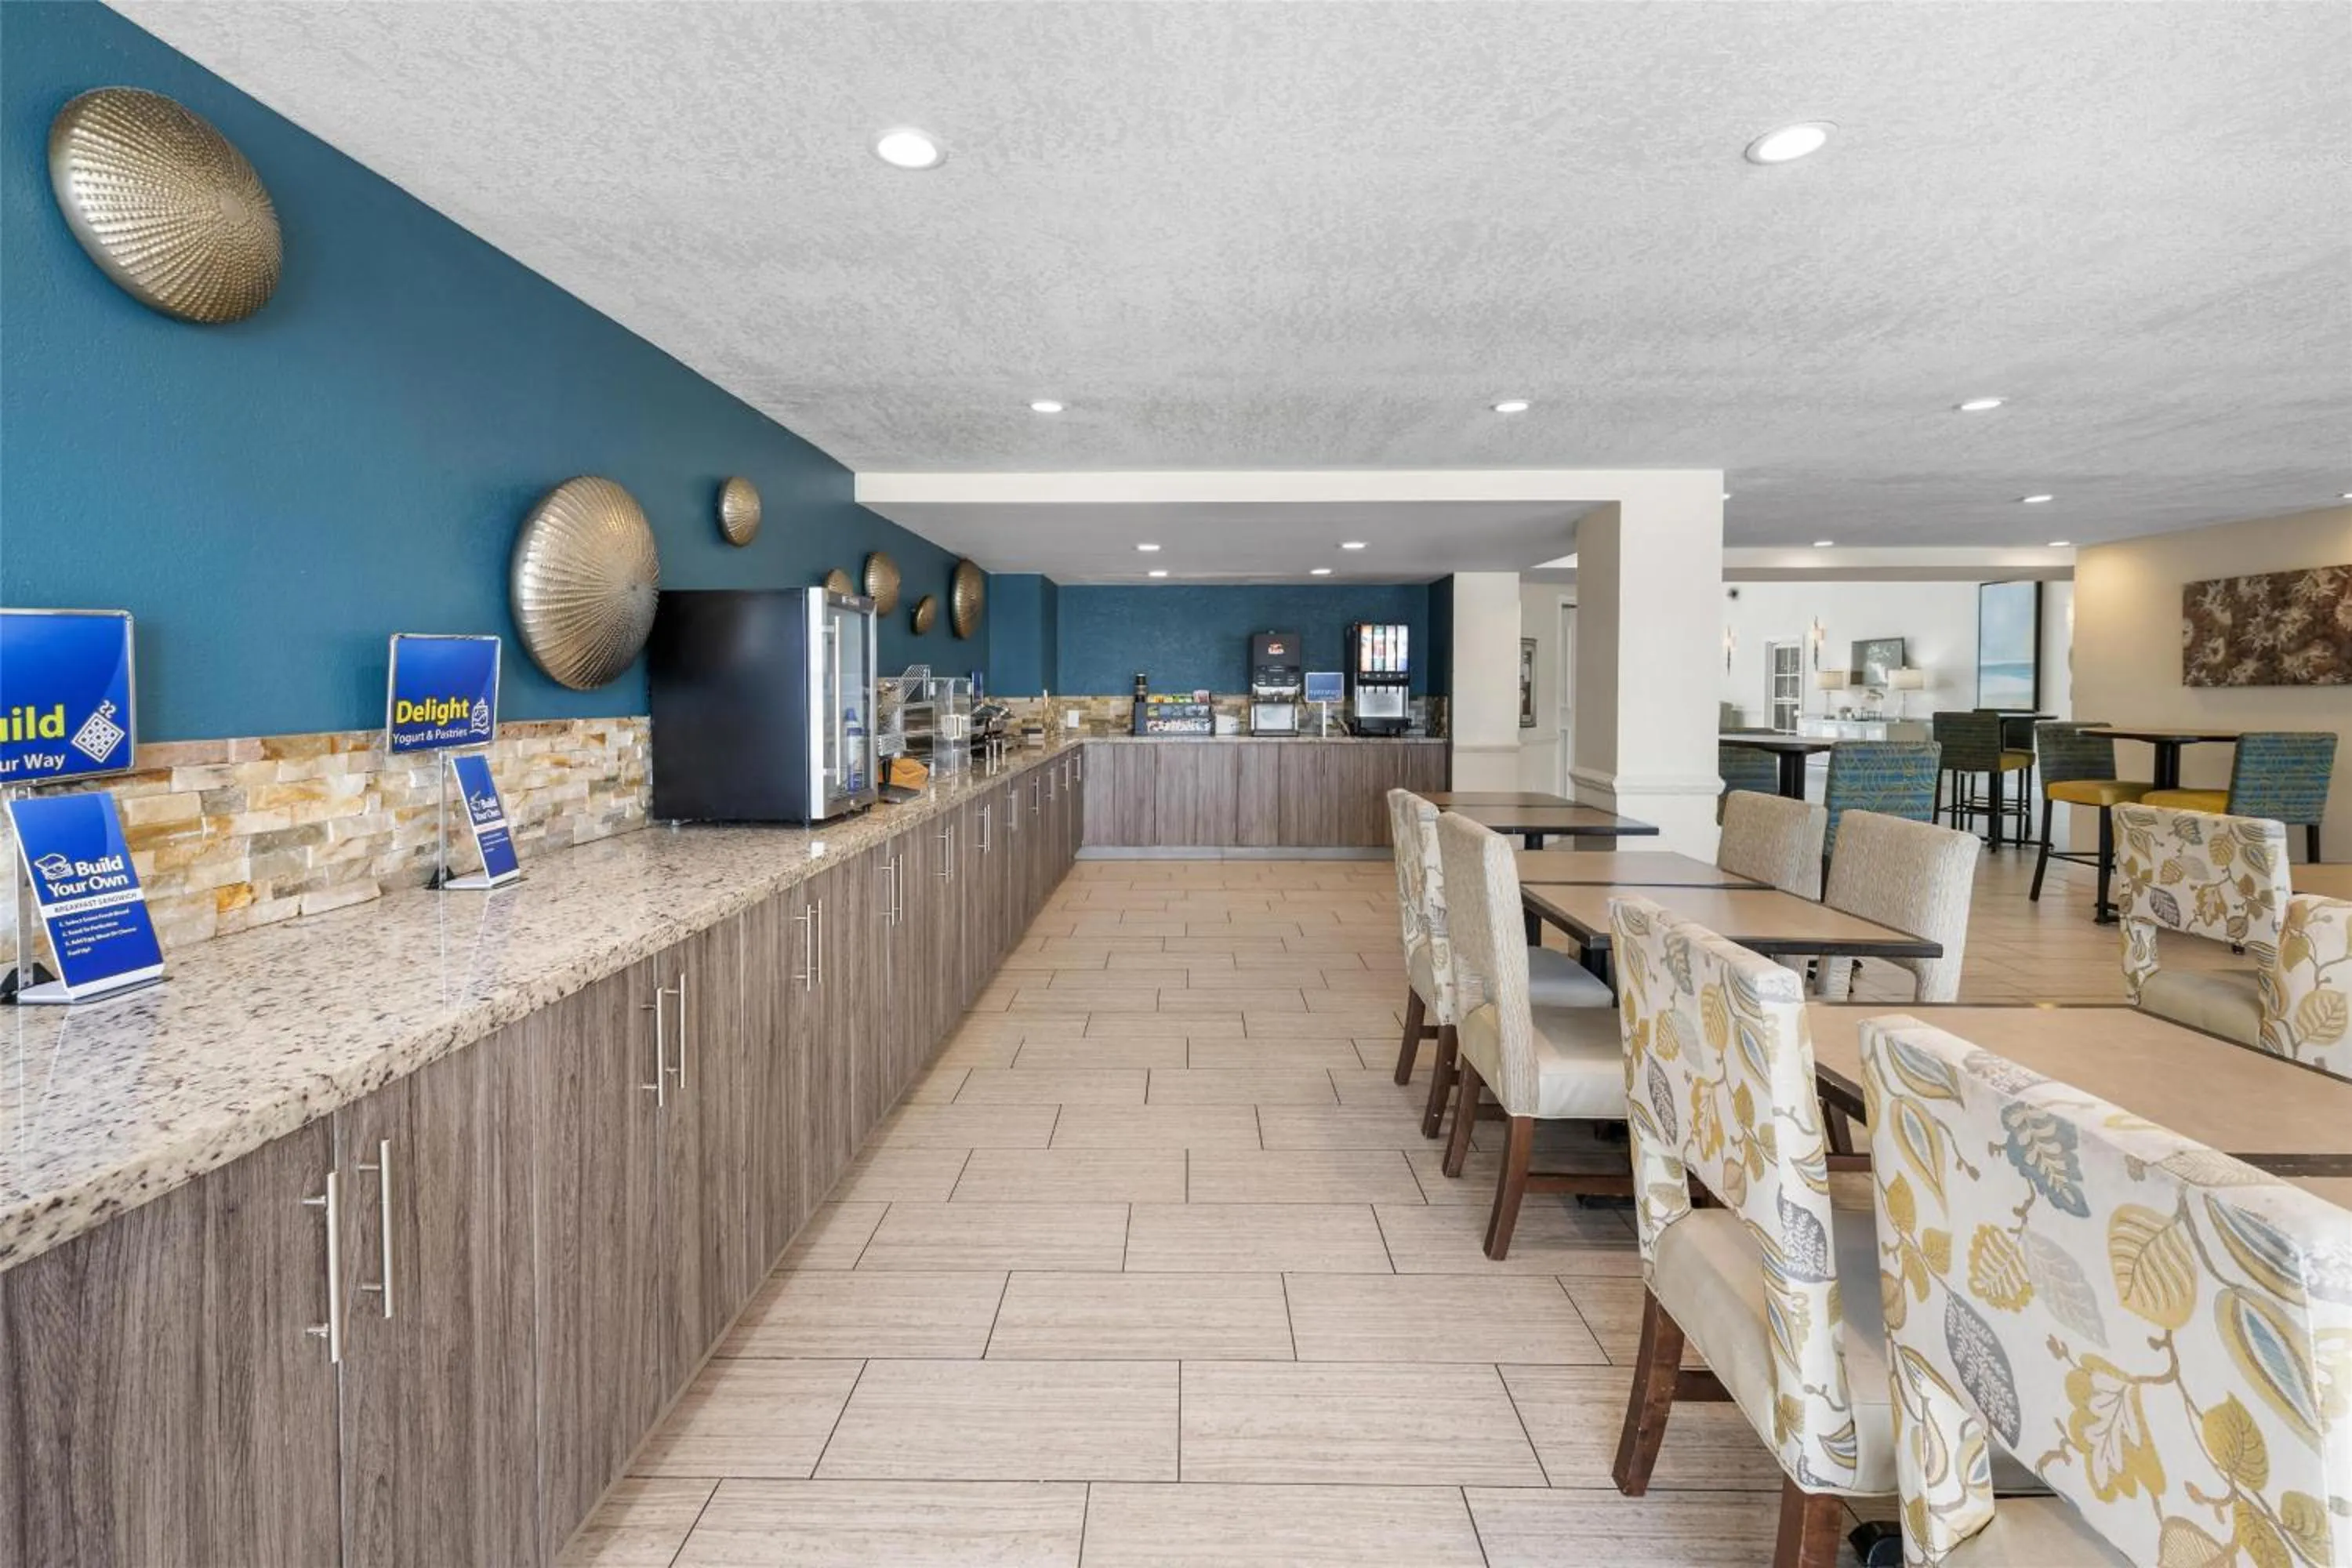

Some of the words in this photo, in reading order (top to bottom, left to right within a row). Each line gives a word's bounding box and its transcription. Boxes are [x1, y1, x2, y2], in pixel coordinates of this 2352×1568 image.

[396, 696, 470, 726] Delight
[393, 731, 424, 746] Yogurt
[426, 730, 434, 741] &
[434, 727, 468, 739] Pastries
[24, 753, 66, 771] Way
[74, 855, 124, 877] Build
[47, 881, 88, 898] Your
[89, 873, 129, 890] Own
[54, 900, 96, 913] BREAKFAST
[99, 893, 137, 907] SANDWICH
